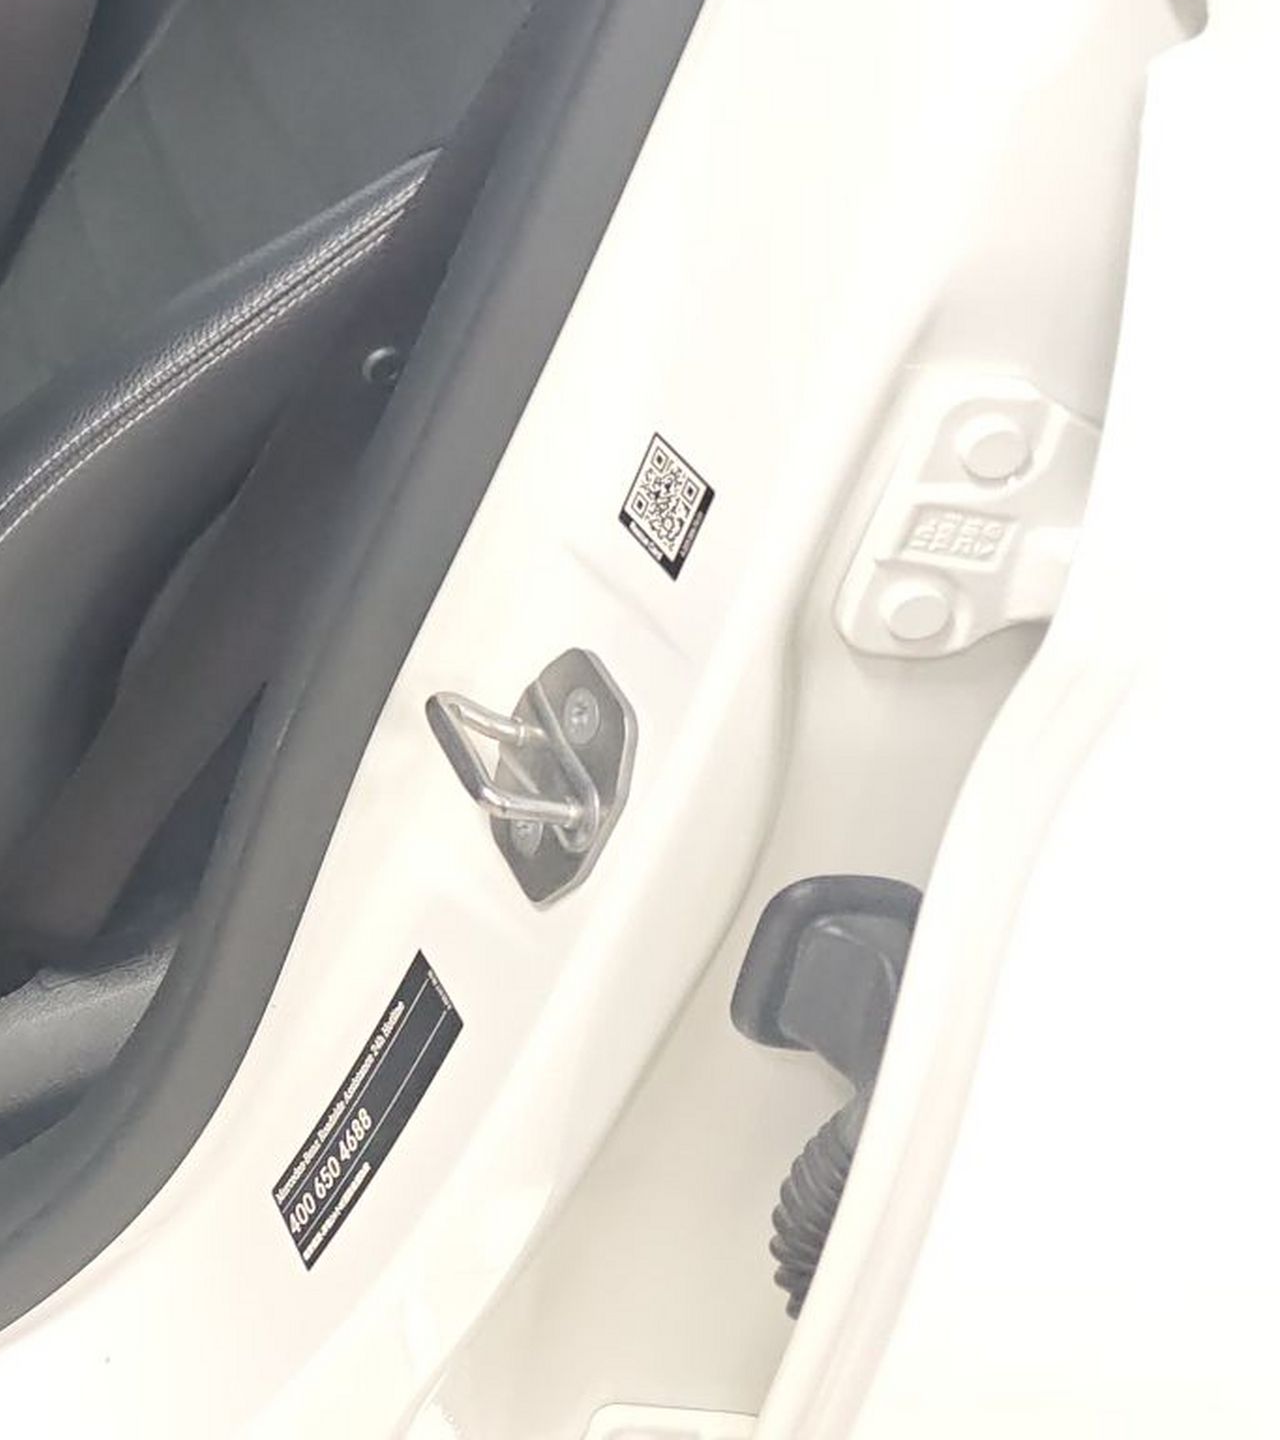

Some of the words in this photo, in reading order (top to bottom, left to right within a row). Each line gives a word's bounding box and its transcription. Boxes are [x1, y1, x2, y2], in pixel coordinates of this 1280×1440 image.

[289, 1192, 316, 1233] 400
[314, 1156, 341, 1200] 650
[338, 1107, 372, 1161] 4688
